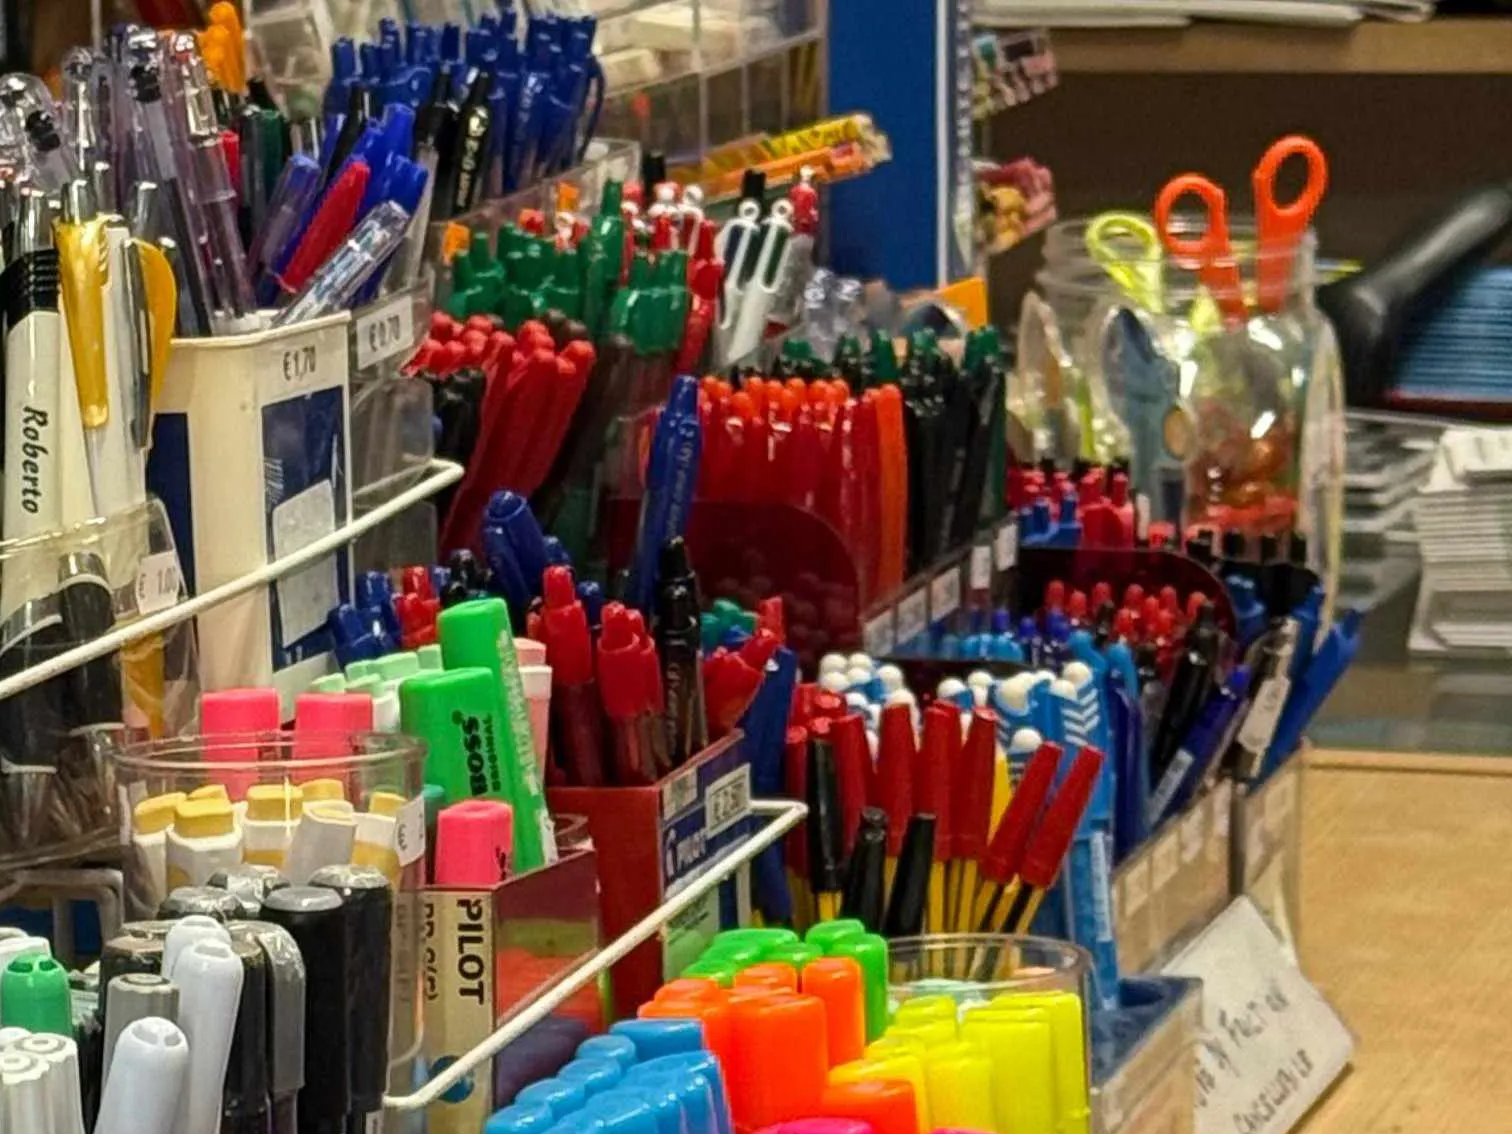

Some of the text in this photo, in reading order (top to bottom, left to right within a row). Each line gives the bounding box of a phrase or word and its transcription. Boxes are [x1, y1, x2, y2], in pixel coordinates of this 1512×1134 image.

[22, 405, 49, 516] Roberto
[461, 713, 487, 796] BOSS
[457, 899, 484, 1005] PILOT
